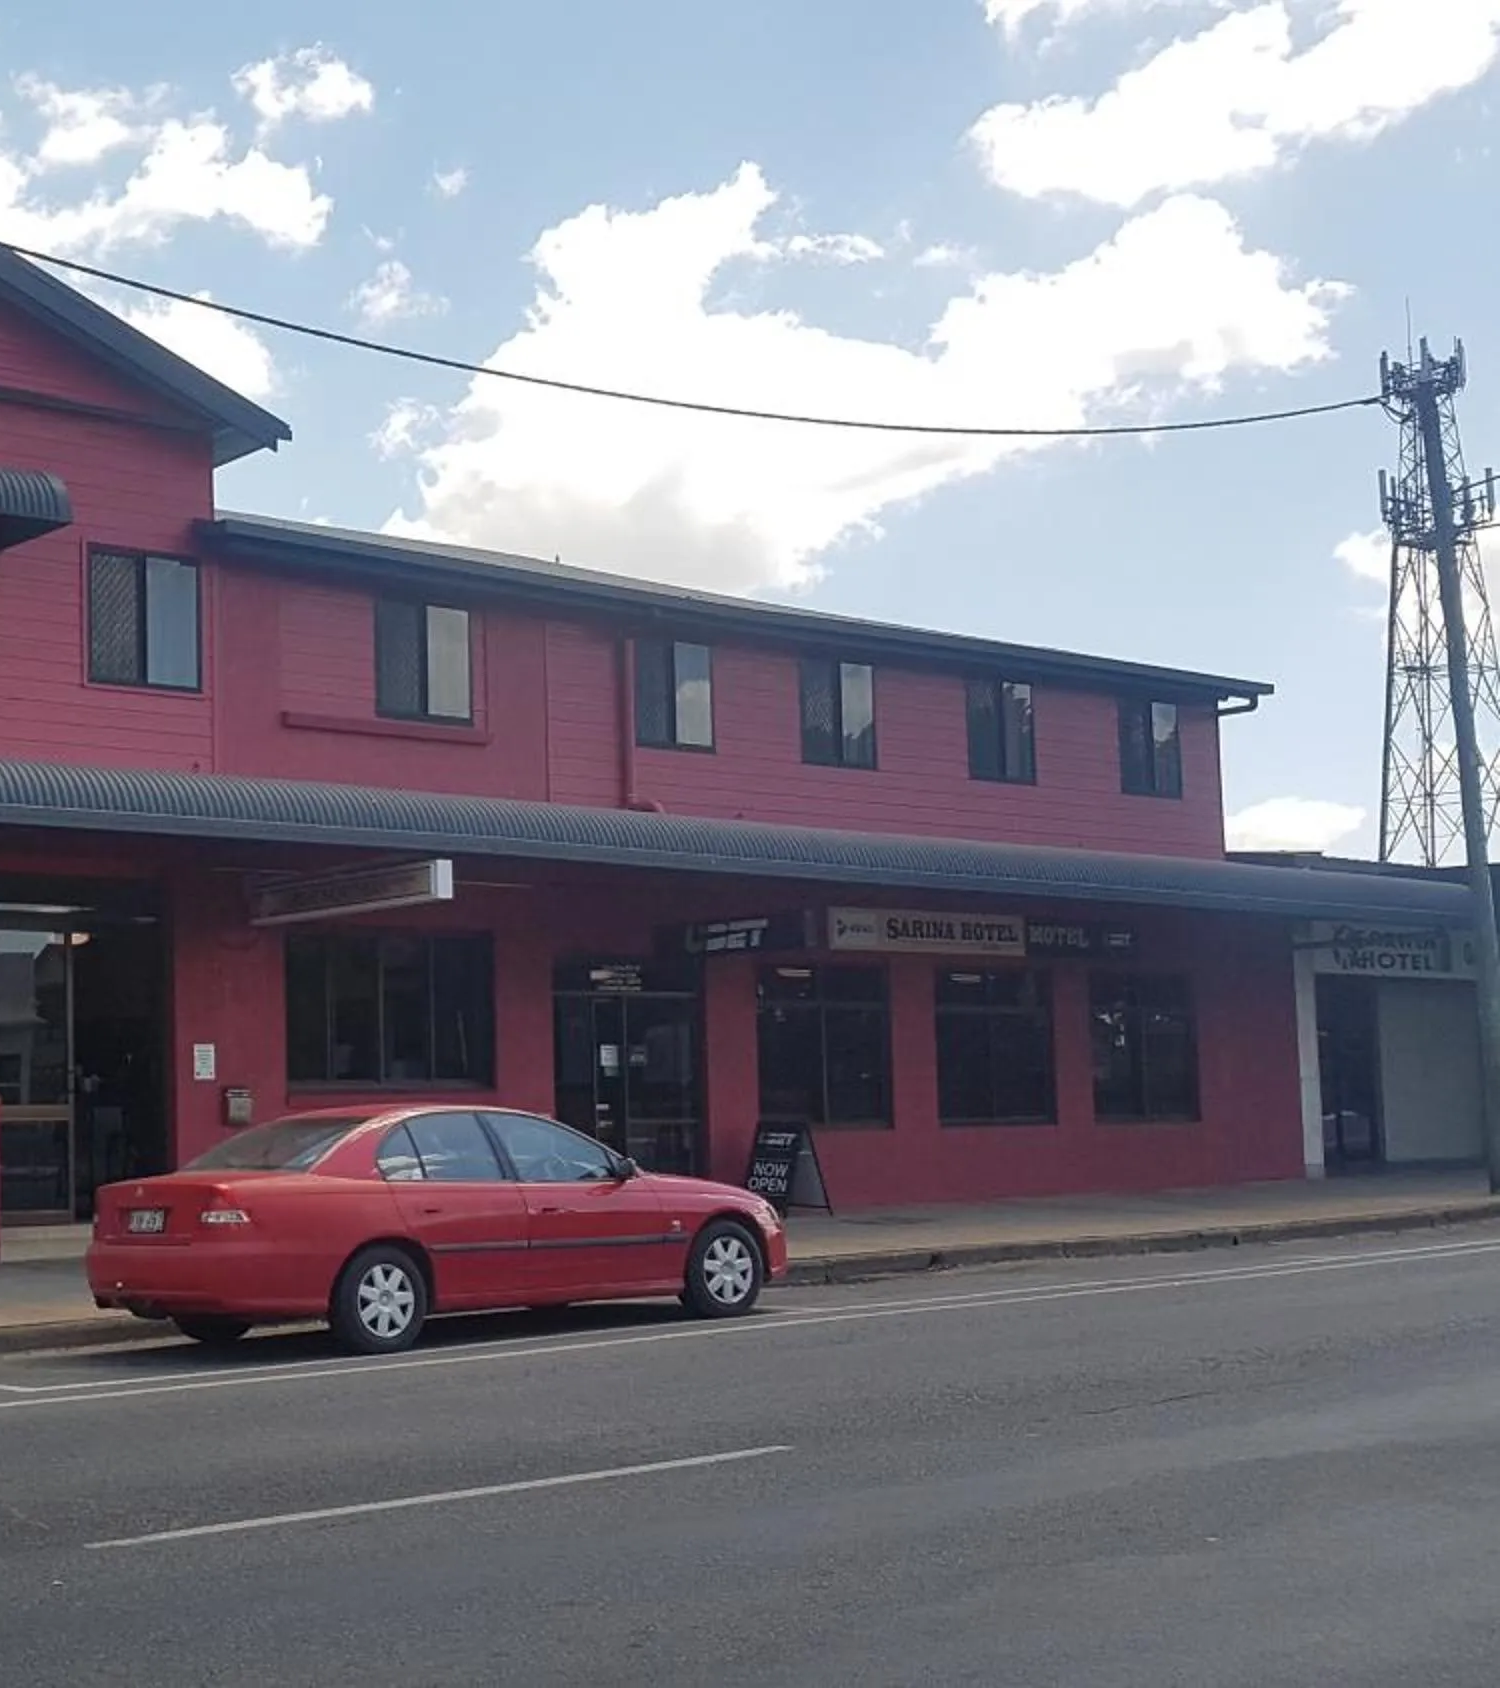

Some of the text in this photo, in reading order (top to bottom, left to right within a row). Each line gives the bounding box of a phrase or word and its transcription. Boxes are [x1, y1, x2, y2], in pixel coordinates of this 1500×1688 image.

[886, 917, 956, 941] SARINA
[961, 921, 1020, 942] HOTEL
[753, 1161, 788, 1177] NOW
[747, 1176, 787, 1192] OPEN
